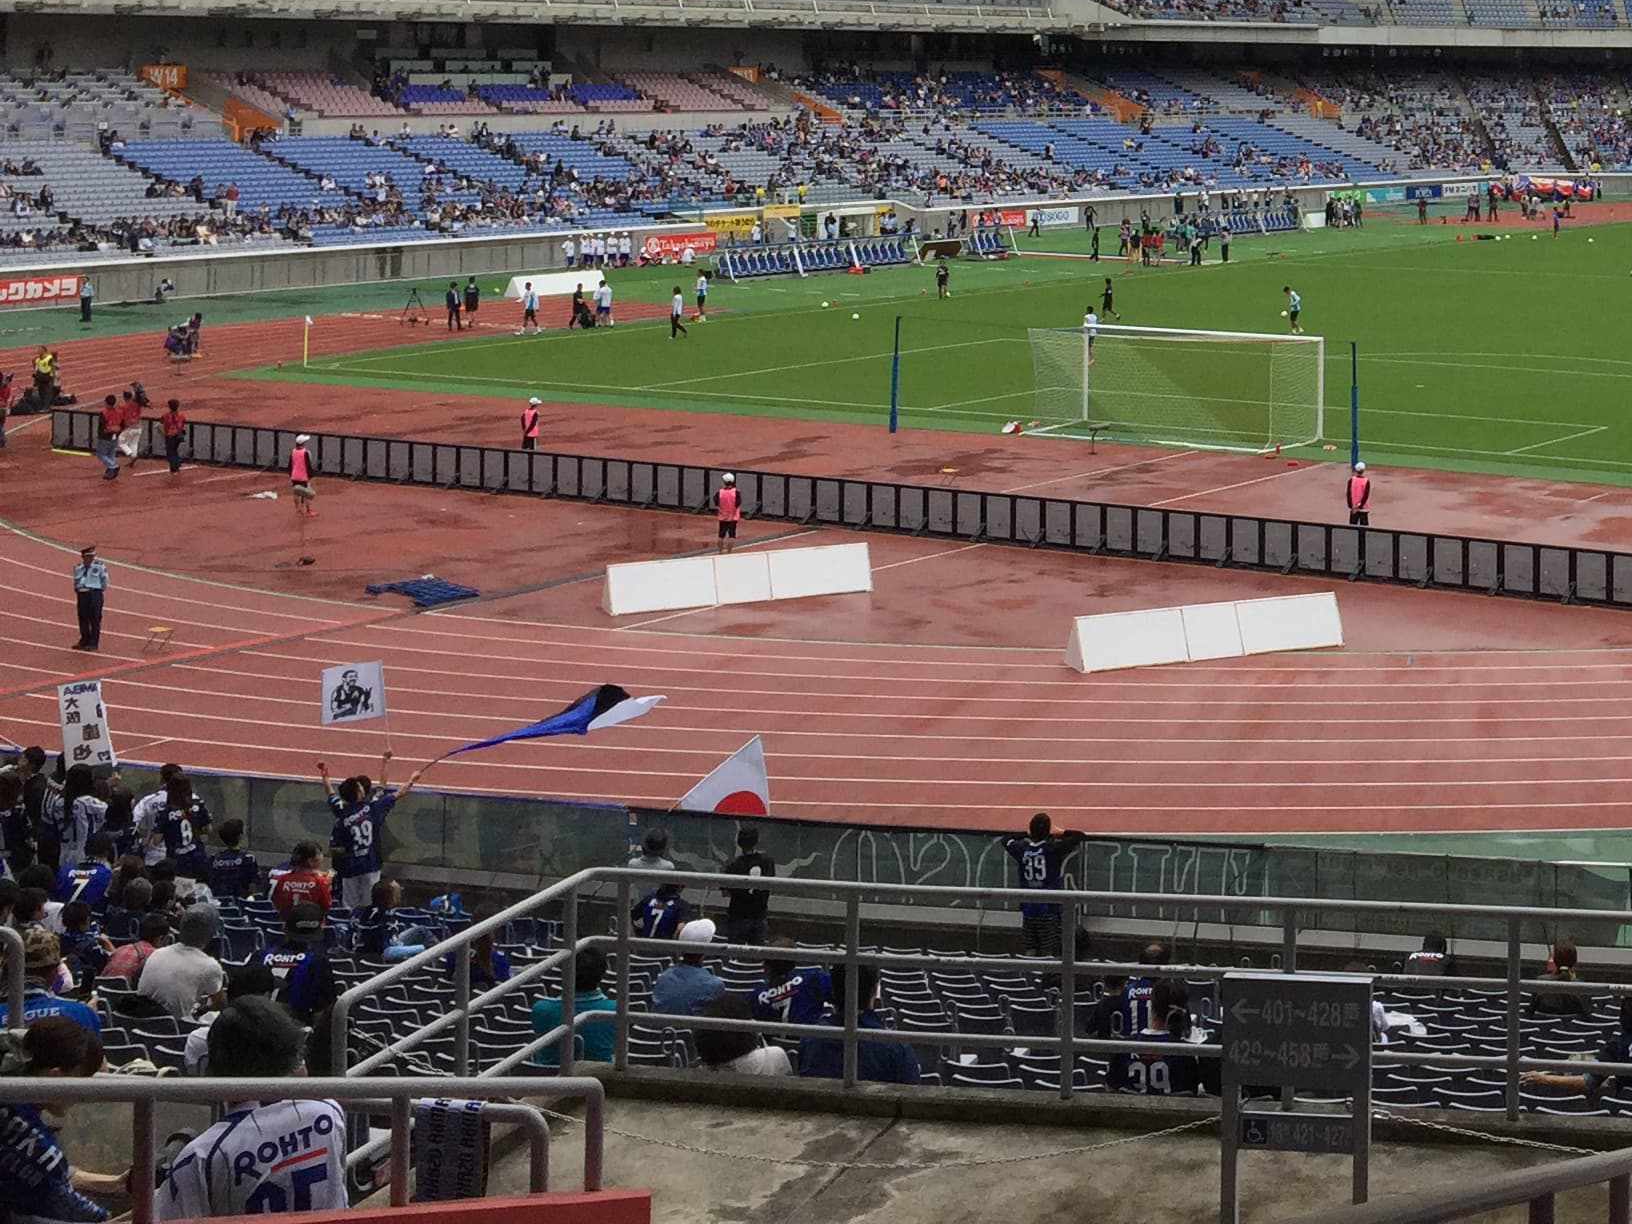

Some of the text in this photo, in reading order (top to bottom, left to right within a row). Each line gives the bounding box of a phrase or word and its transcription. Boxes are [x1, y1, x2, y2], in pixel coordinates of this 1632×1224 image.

[350, 819, 373, 850] 39
[1022, 855, 1047, 881] 39
[70, 878, 90, 903] 7
[650, 908, 665, 938] 7
[263, 952, 306, 966] ROHTO
[758, 975, 803, 1005] ROHTO
[1128, 987, 1153, 1000] ROHT
[1128, 1061, 1172, 1094] 39
[233, 1114, 334, 1187] ROHTO
